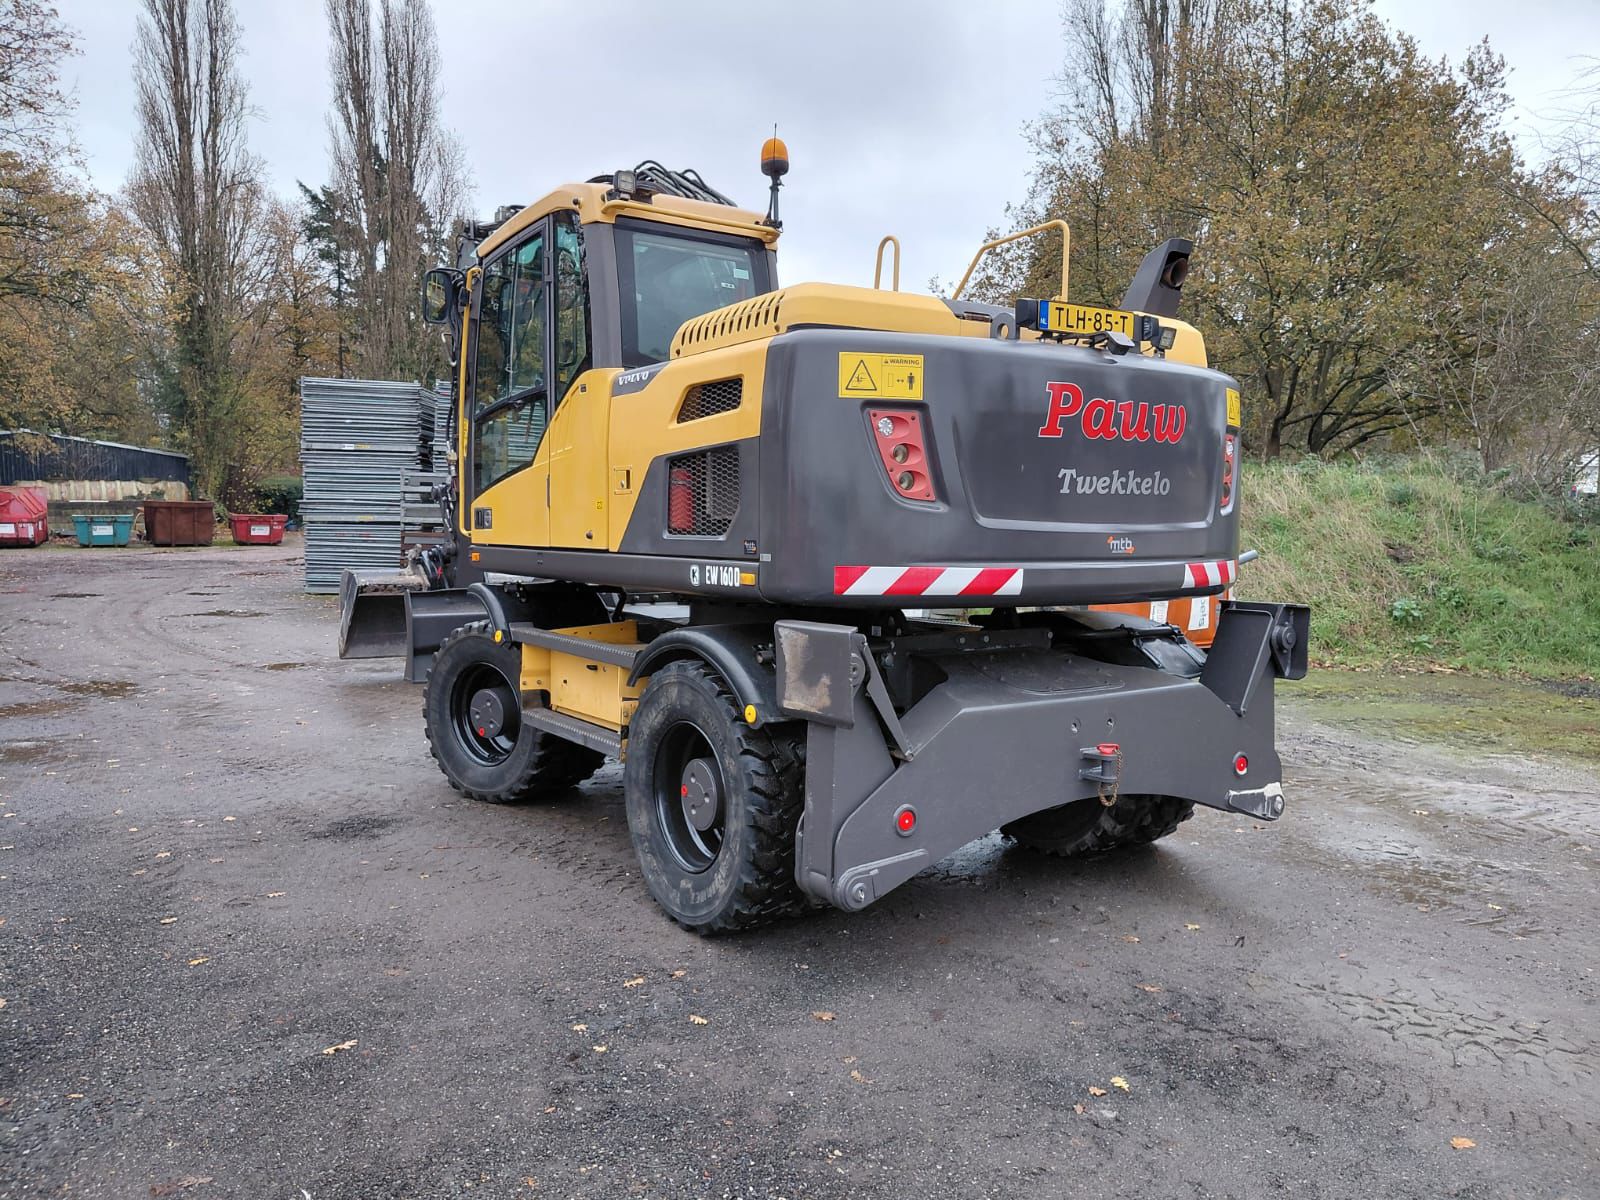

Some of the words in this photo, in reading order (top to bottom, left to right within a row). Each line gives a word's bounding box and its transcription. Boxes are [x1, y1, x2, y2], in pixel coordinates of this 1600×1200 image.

[1055, 306, 1129, 334] TLH-85-T
[889, 358, 920, 366] WARNING
[618, 370, 650, 386] VOLVO
[1038, 381, 1187, 444] Pauw
[1057, 468, 1171, 496] Twekkelo
[1110, 537, 1133, 551] mtb
